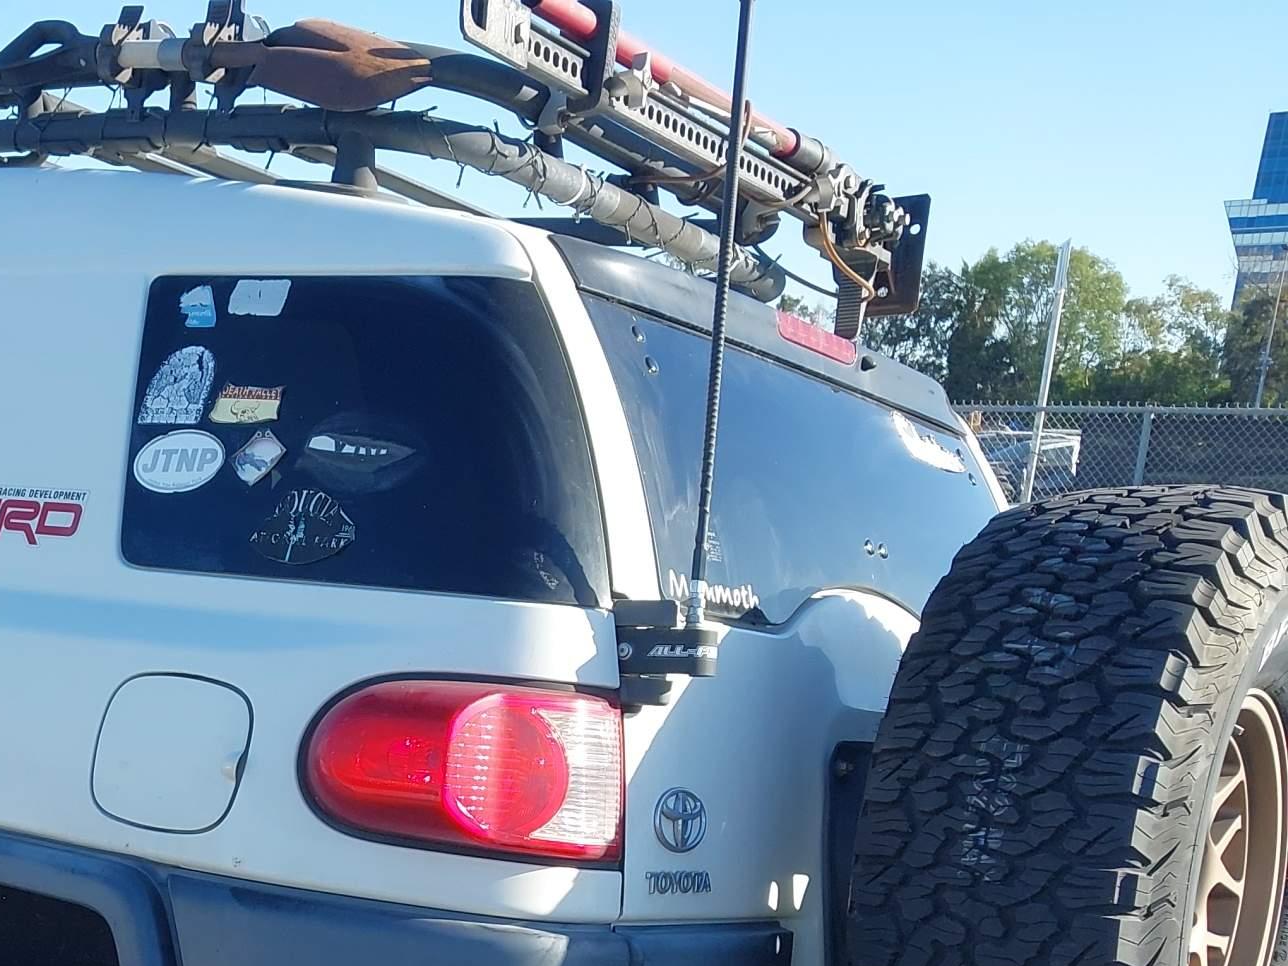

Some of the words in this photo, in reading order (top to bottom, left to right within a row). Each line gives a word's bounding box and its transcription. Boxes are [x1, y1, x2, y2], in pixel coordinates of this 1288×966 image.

[142, 447, 218, 473] JTNP
[29, 489, 87, 501] DEVELOPMENT
[669, 567, 761, 609] Mmmoth
[645, 871, 711, 894] TOYOTA
